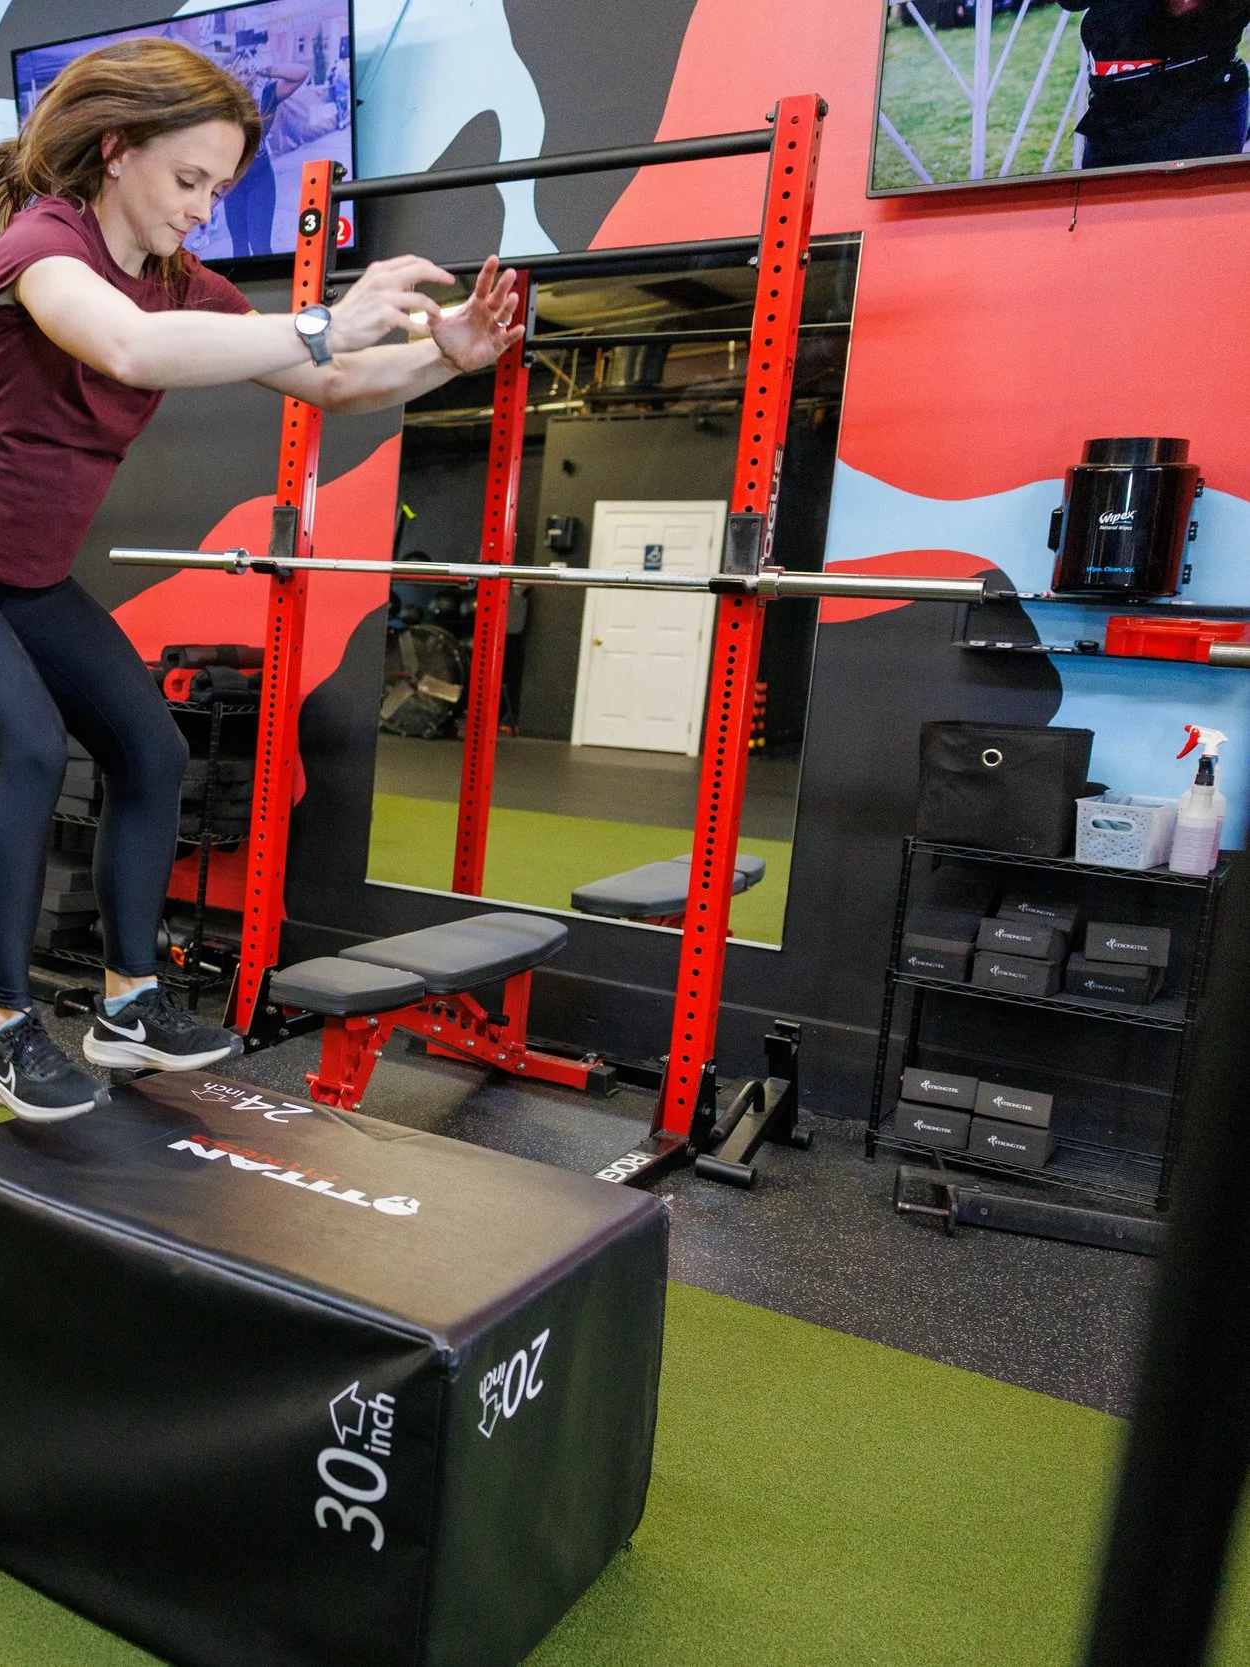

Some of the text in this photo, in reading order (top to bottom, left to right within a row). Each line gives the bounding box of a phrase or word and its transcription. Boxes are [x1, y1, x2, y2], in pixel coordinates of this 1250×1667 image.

[305, 214, 316, 232] 3
[337, 220, 345, 240] 2
[764, 446, 783, 558] OGUE
[1099, 510, 1136, 524] Wipex
[203, 1081, 314, 1124] 24 inch
[167, 1139, 372, 1208] TITAN
[190, 1134, 340, 1181] FITNESS
[594, 1153, 652, 1184] ROG
[479, 1328, 550, 1419] 20 inch
[314, 1392, 396, 1552] 30 inch
